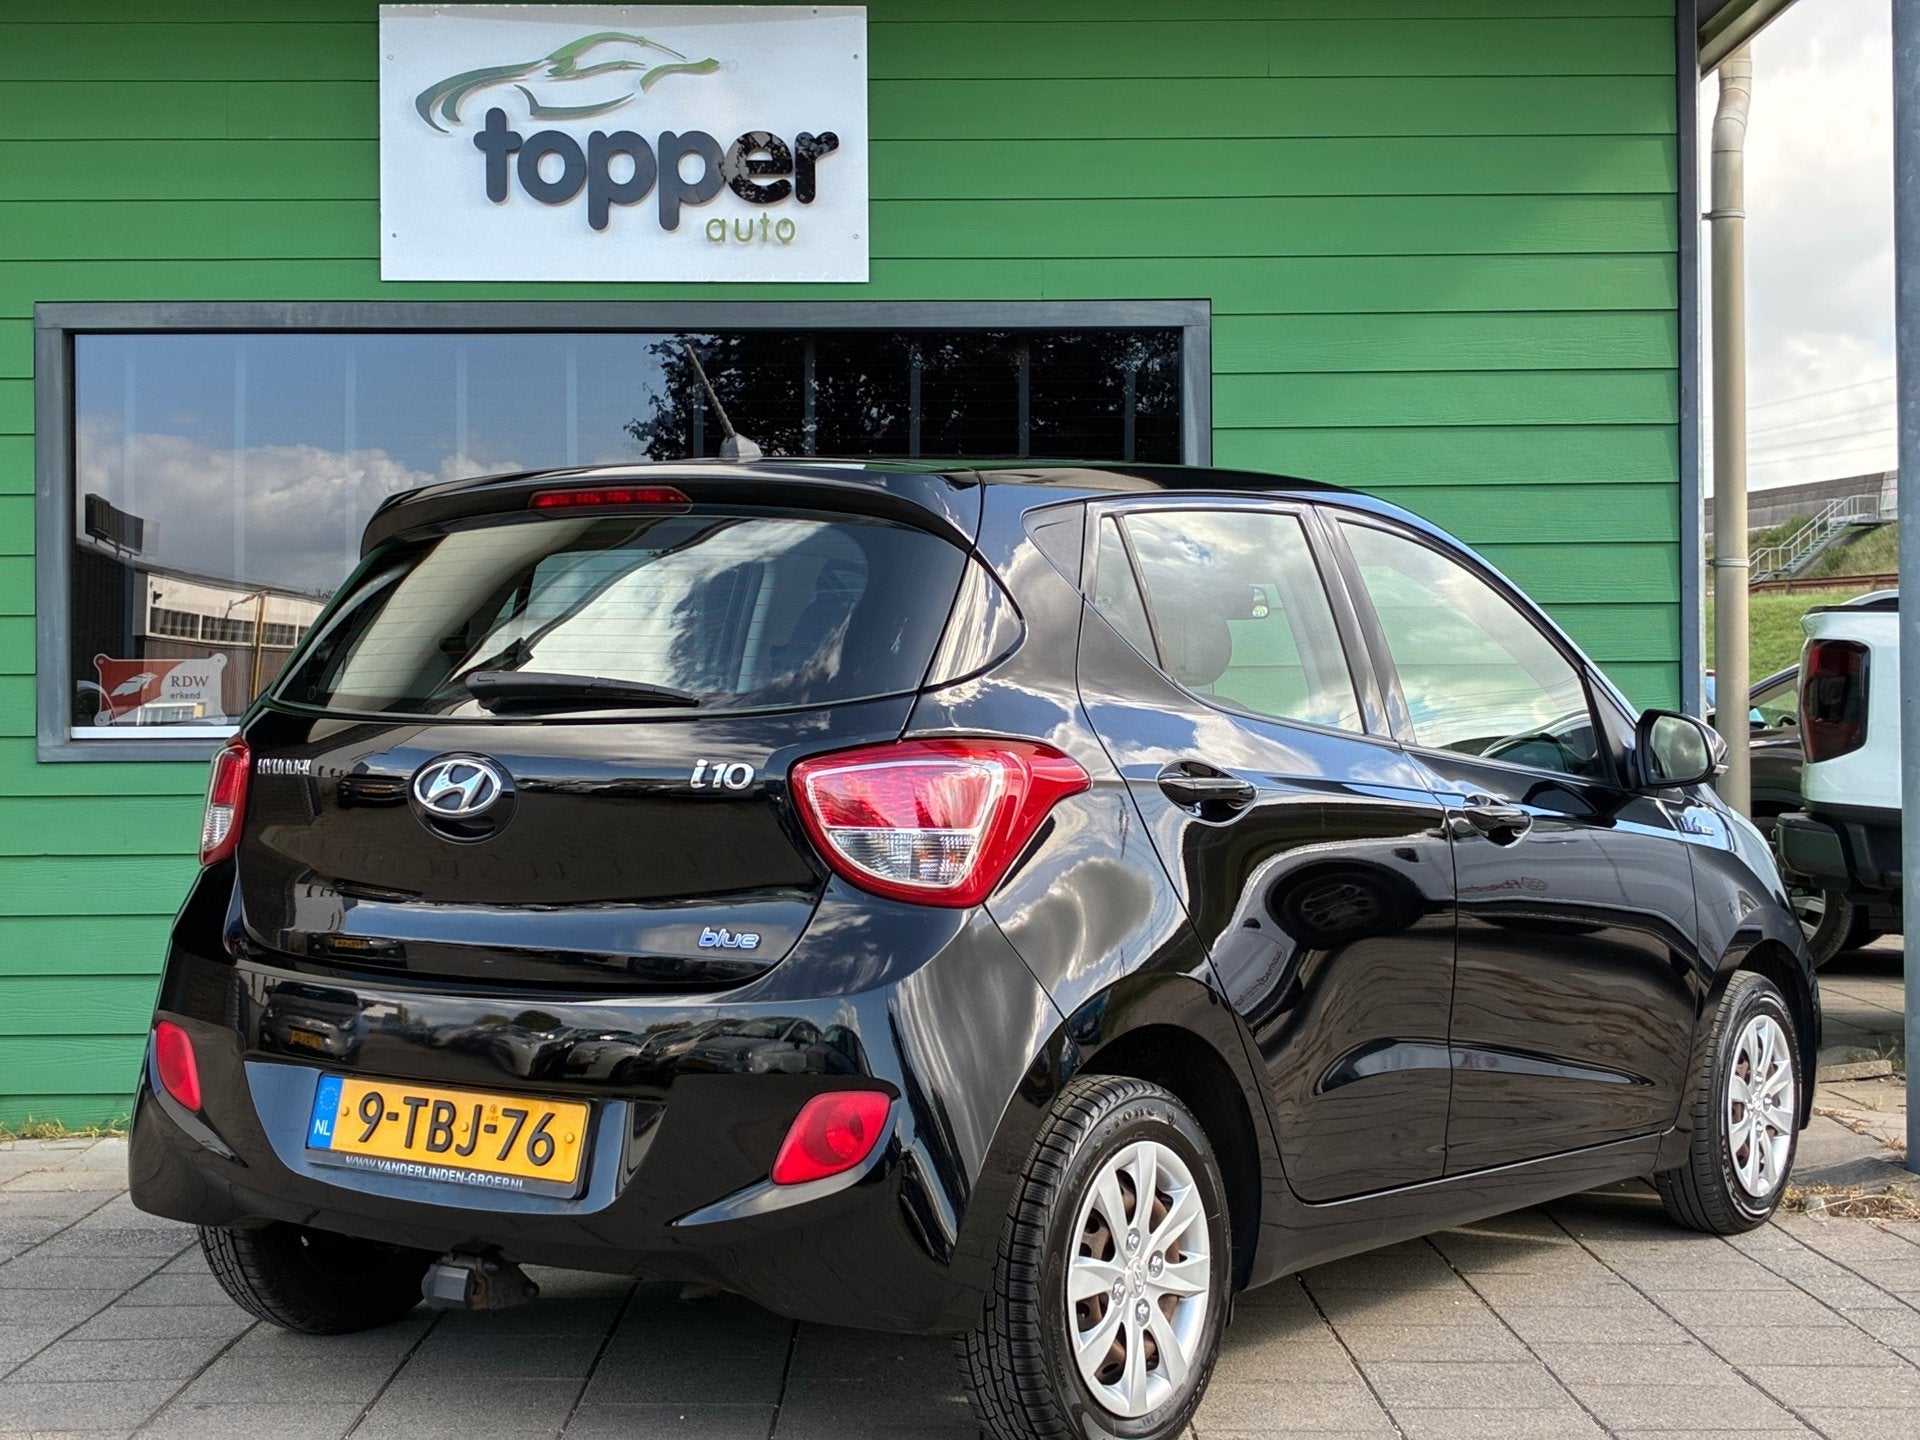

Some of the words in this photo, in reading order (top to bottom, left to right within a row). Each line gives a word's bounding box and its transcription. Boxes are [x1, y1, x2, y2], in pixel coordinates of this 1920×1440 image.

[473, 107, 840, 231] topper
[705, 212, 797, 244] auto
[170, 675, 209, 688] RDW
[170, 690, 201, 700] erkend
[690, 758, 755, 790] i10
[698, 926, 760, 949] blue
[313, 1118, 331, 1136] NL
[357, 1091, 556, 1166] 9-TBJ-76
